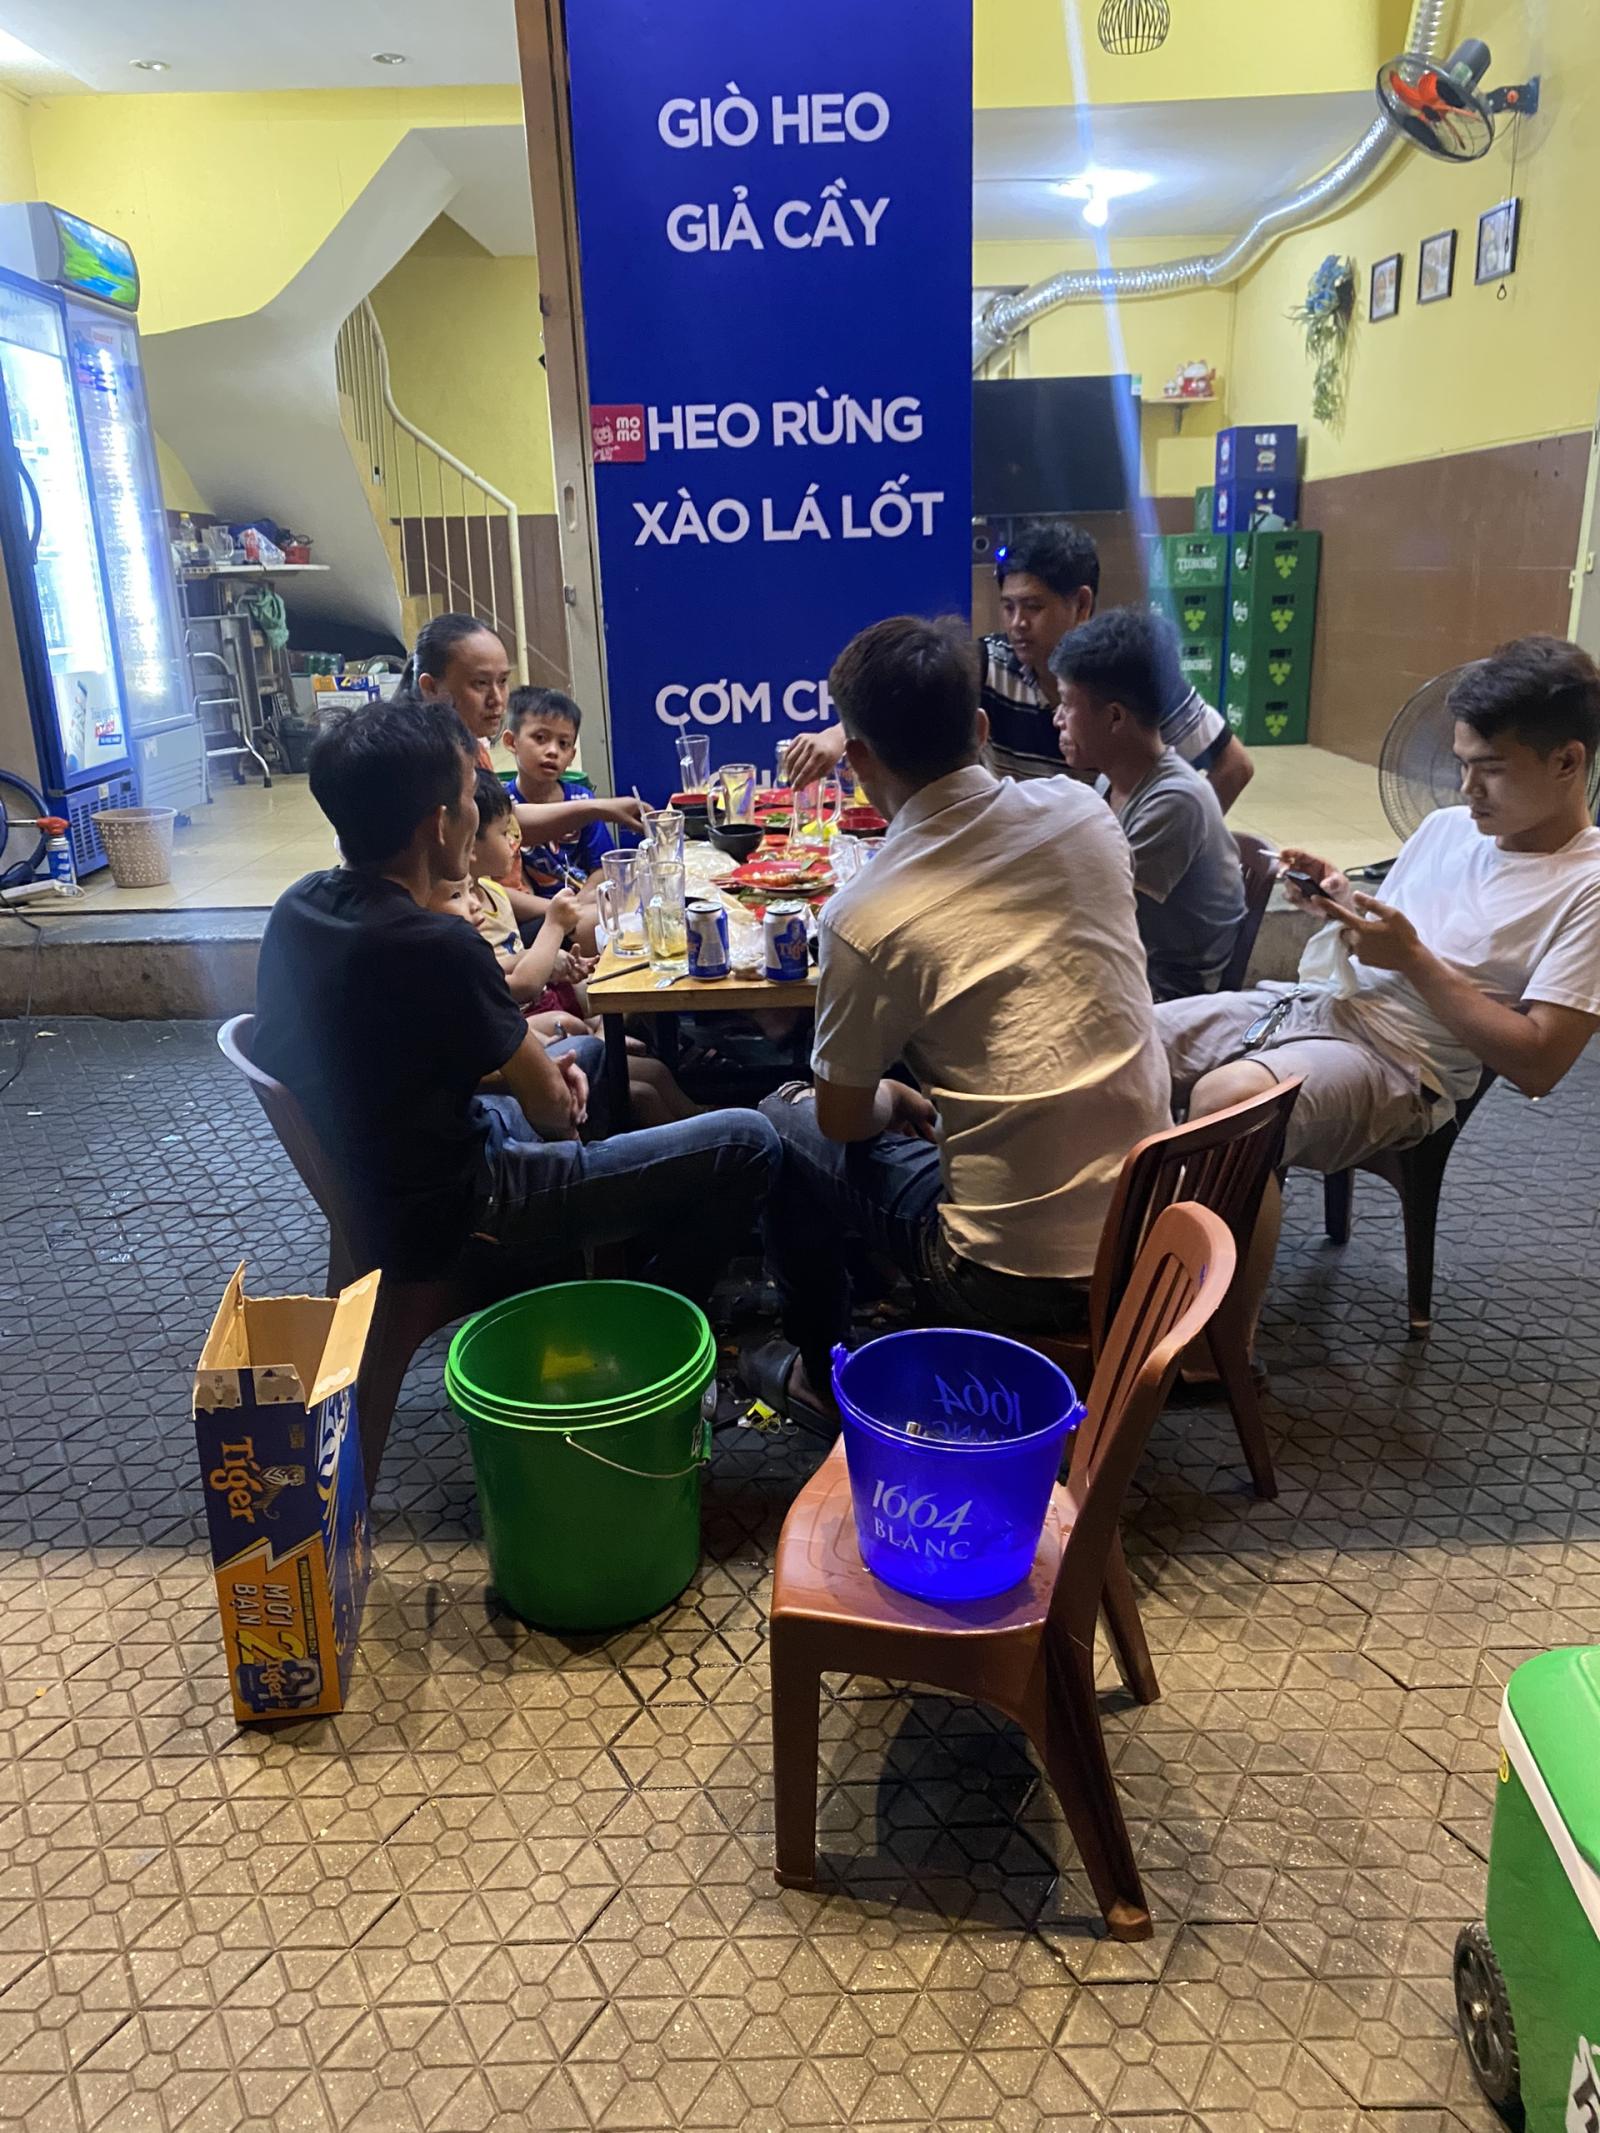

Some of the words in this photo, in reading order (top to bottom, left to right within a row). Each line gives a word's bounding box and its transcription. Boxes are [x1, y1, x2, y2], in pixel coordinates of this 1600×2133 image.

[658, 81, 759, 148] GIÒ
[772, 91, 890, 145] HEO
[666, 185, 764, 252] GIẢ
[773, 177, 890, 249] CẦY
[648, 403, 760, 451] HEO
[772, 386, 923, 446] RỪNG
[632, 487, 750, 546] XÀO
[762, 483, 831, 541] LÁ
[841, 474, 944, 538] LỐT
[655, 678, 772, 726] CƠM
[783, 679, 835, 722] CH
[209, 1436, 263, 1524] Tiger
[871, 1479, 973, 1536] 1664
[874, 1516, 971, 1560] BLANC
